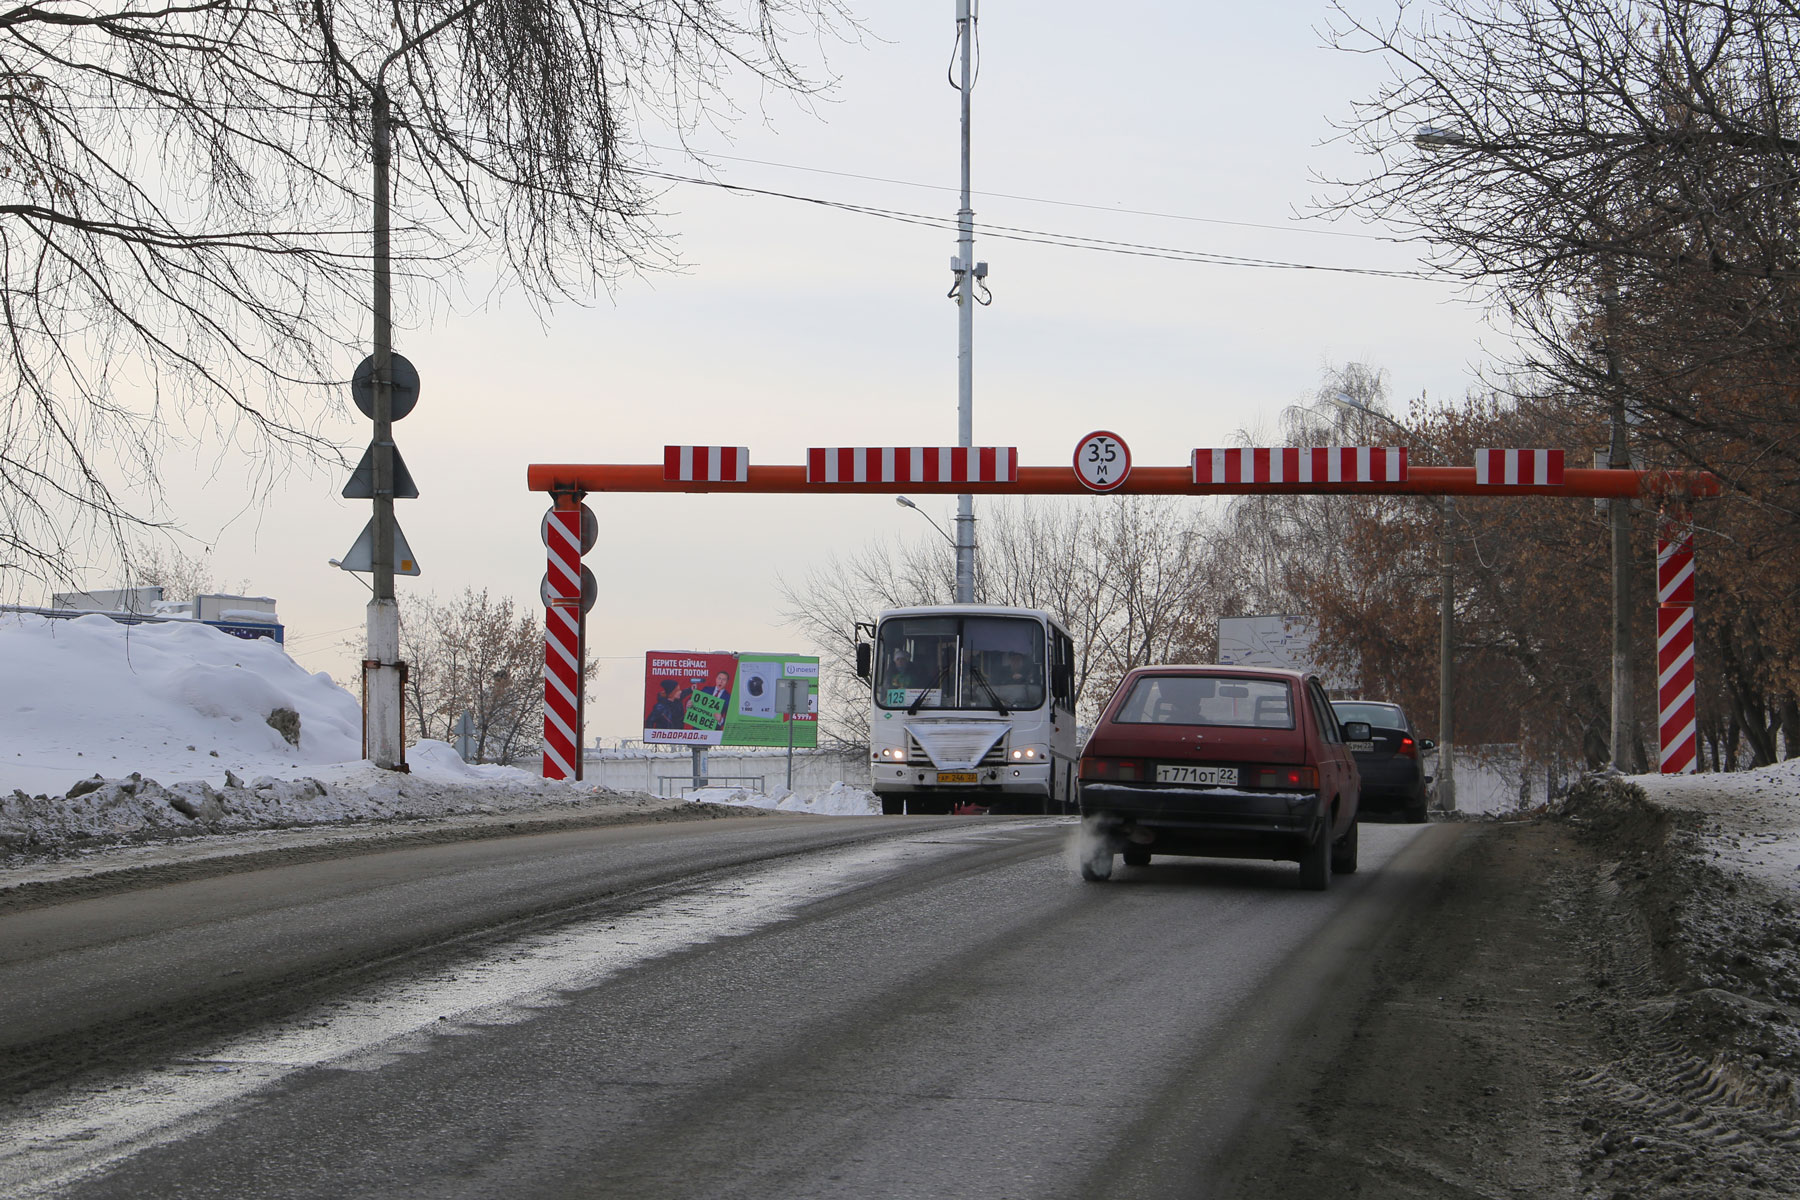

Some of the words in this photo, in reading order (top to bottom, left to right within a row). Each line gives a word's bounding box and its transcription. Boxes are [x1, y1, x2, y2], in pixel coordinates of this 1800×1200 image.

[1088, 443, 1116, 464] 3,5
[1097, 465, 1108, 475] М
[652, 659, 678, 668] БЕРИТЕ
[678, 659, 707, 668] СЕЙЧАС!
[652, 668, 682, 677] ПЛАТИТЕ
[683, 669, 709, 677] ПОТОМ!
[888, 692, 905, 705] 125
[687, 711, 698, 724] НА
[699, 715, 715, 730] ВСЁ
[1219, 769, 1234, 780] 22
